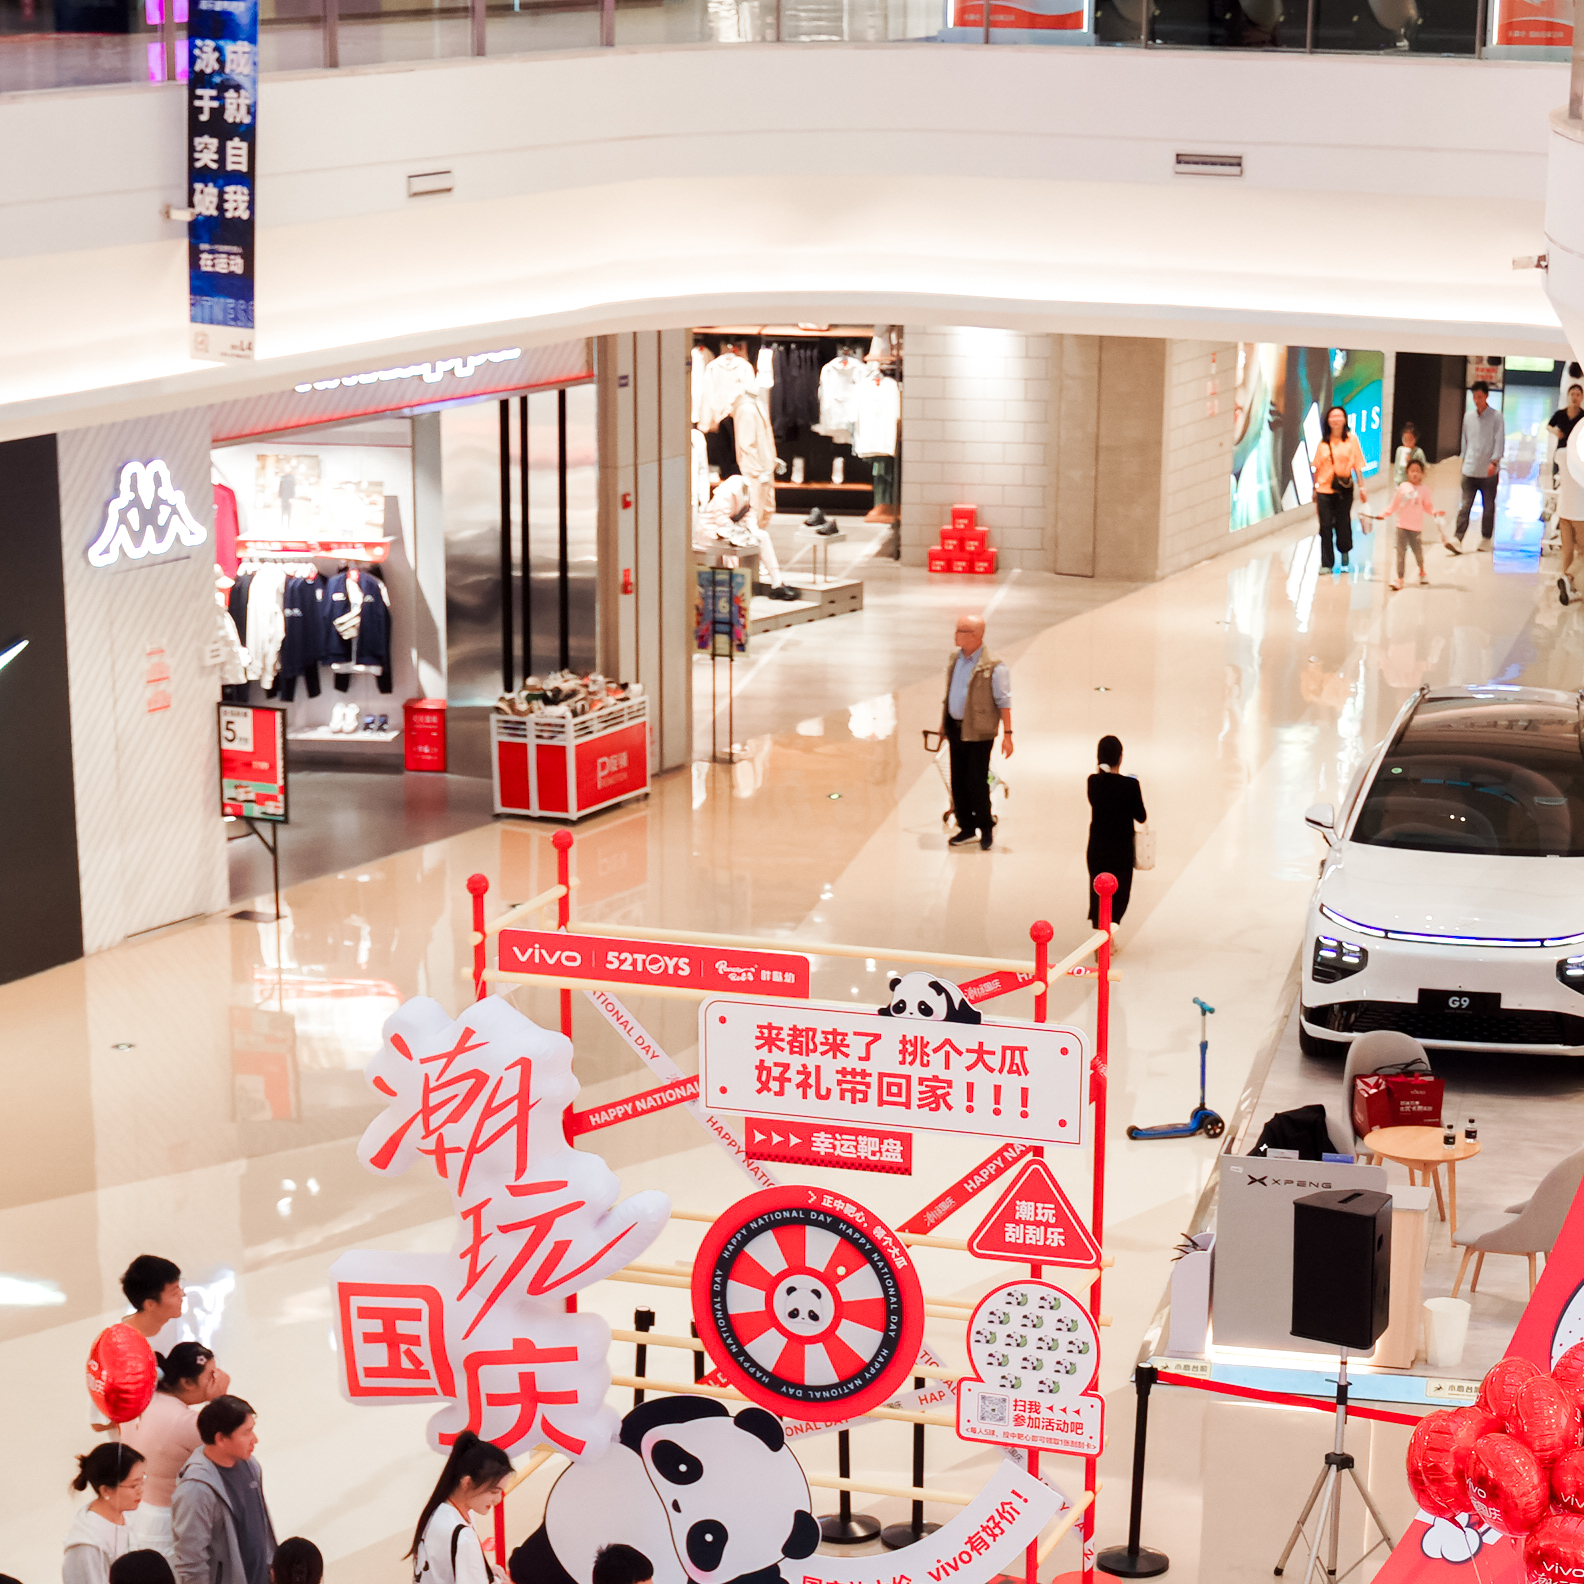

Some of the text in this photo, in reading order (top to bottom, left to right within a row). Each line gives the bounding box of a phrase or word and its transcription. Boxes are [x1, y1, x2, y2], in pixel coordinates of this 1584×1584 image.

[512, 943, 582, 968] vivo
[605, 951, 691, 977] 52TOYS
[1448, 996, 1470, 1008] G9
[633, 1034, 661, 1062] DAY
[754, 1021, 1031, 1077] 来都来了 挑个大瓜
[589, 1101, 635, 1127] HAPPY
[706, 1115, 746, 1157] HAPPY
[810, 1131, 904, 1163] 幸运靶盘
[963, 1154, 1007, 1193] HAPPY
[1271, 1178, 1333, 1190] XPENG
[1015, 1200, 1057, 1224] 潮玩
[722, 1210, 833, 1259] HAPPY NATIONAL DAY
[1004, 1223, 1066, 1248] 刮刮乐
[838, 1222, 899, 1338] HAPPY NATIONAL DAY
[713, 1268, 770, 1384] HAPPY NATIONAL DAY
[337, 1281, 587, 1456] 国庆
[780, 1348, 889, 1399] HAPPY NATIONAL DAY
[917, 1389, 947, 1406] HAP
[1012, 1398, 1041, 1415] 扫我
[1013, 1413, 1084, 1436] 参加活动吧
